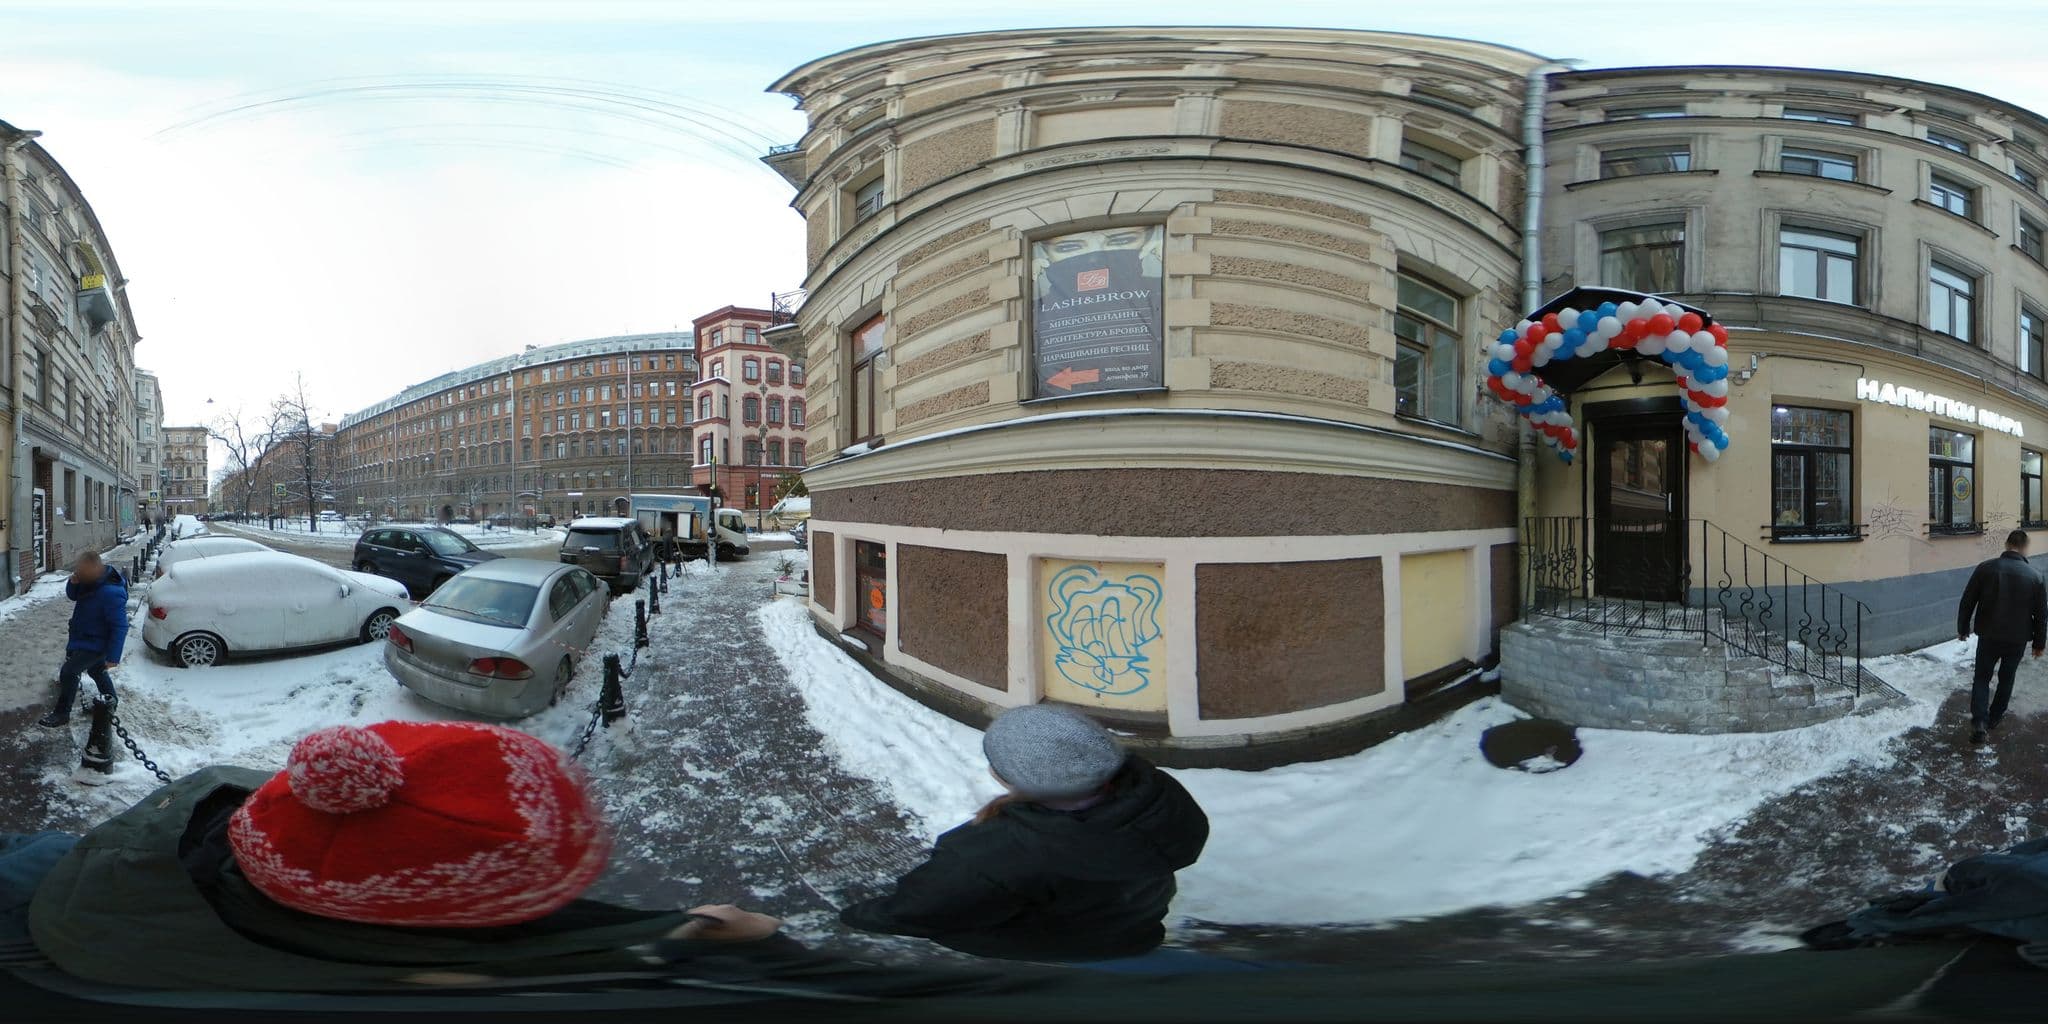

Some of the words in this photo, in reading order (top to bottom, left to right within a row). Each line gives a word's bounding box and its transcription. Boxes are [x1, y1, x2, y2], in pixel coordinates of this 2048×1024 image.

[1041, 289, 1150, 312] LASH&BROW
[1043, 330, 1108, 345] АРХИТЕКТУРА
[1109, 325, 1149, 336] БРОВЕЙ
[1043, 346, 1109, 362] НАРАЩИВАНИЕ
[1110, 343, 1149, 353] РЕСНИЦ
[1856, 377, 1976, 423] НАПИТКИ
